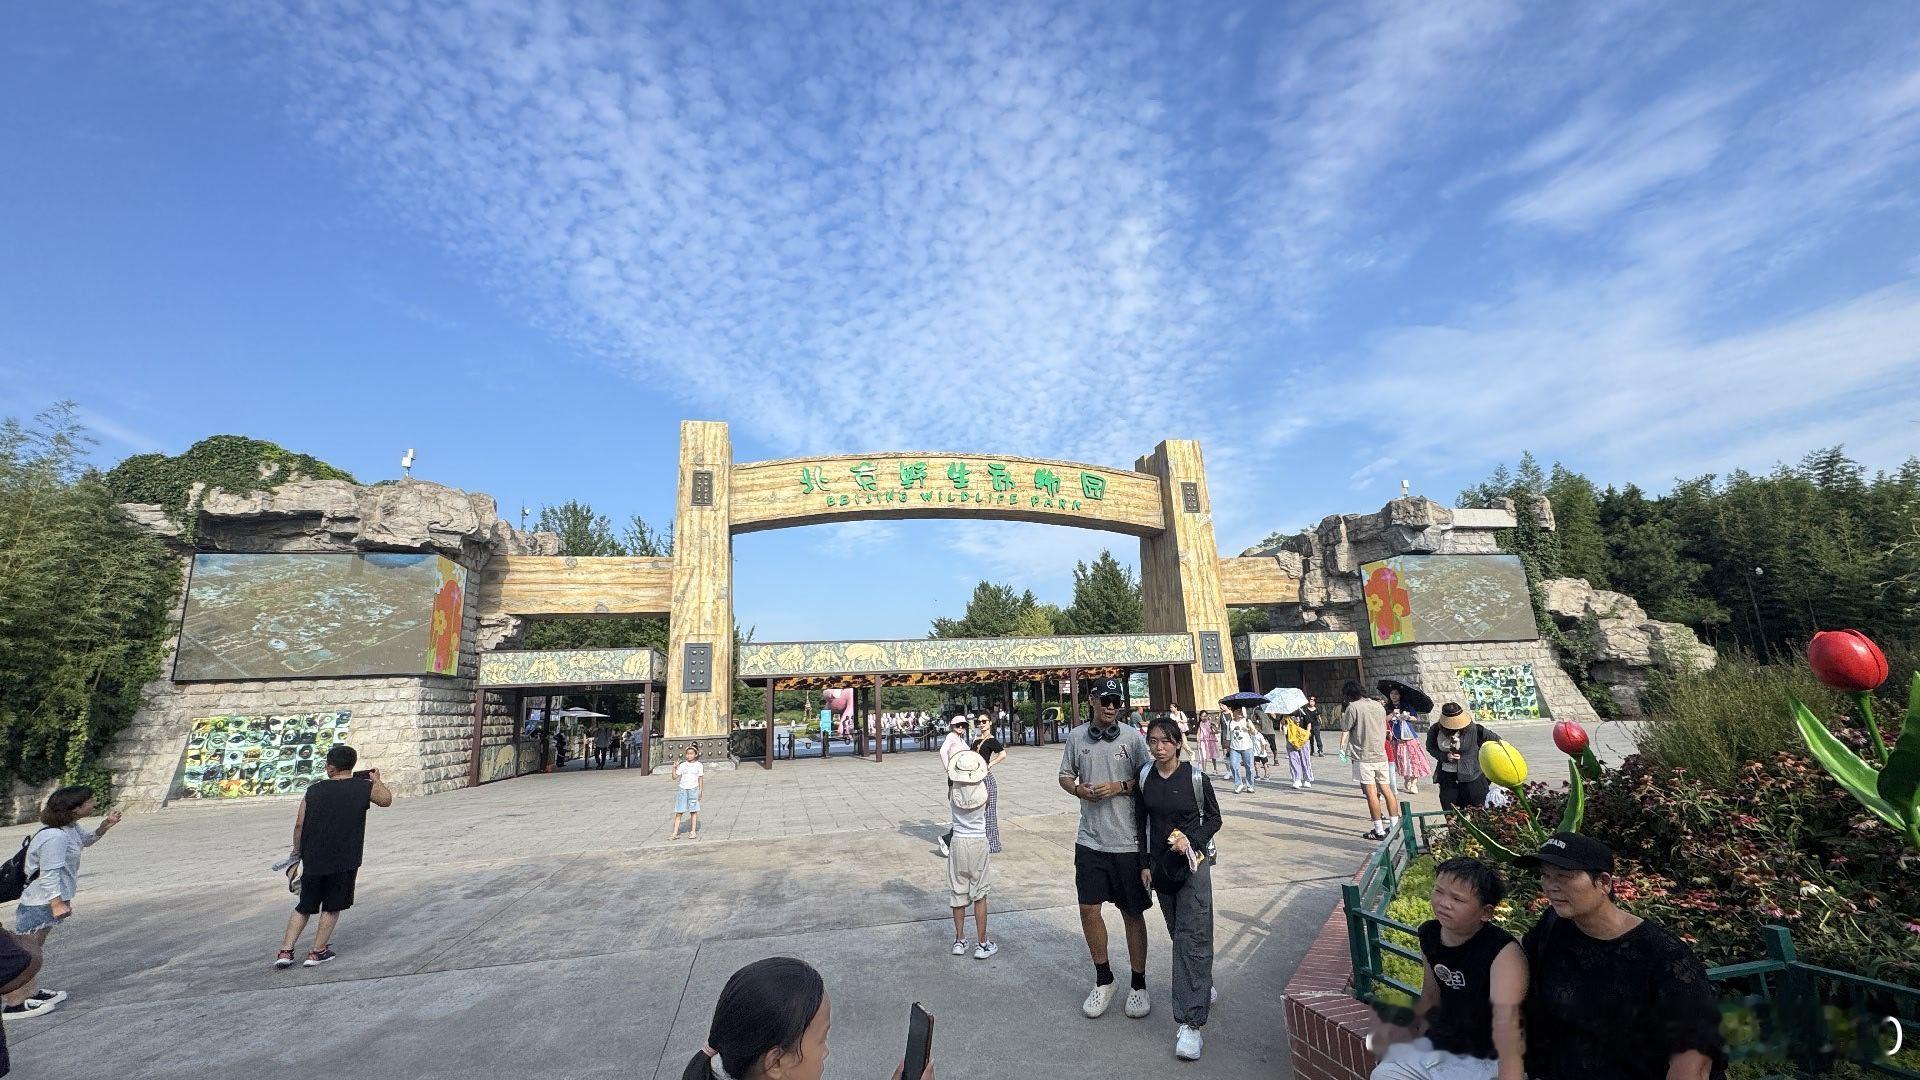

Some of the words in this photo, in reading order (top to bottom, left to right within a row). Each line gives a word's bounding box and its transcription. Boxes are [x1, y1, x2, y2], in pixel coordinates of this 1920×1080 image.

[800, 461, 1107, 501] 北京野生动物园
[826, 490, 908, 507] BEIJING
[920, 491, 1018, 506] WILDLIFE
[1030, 495, 1082, 510] PARK
